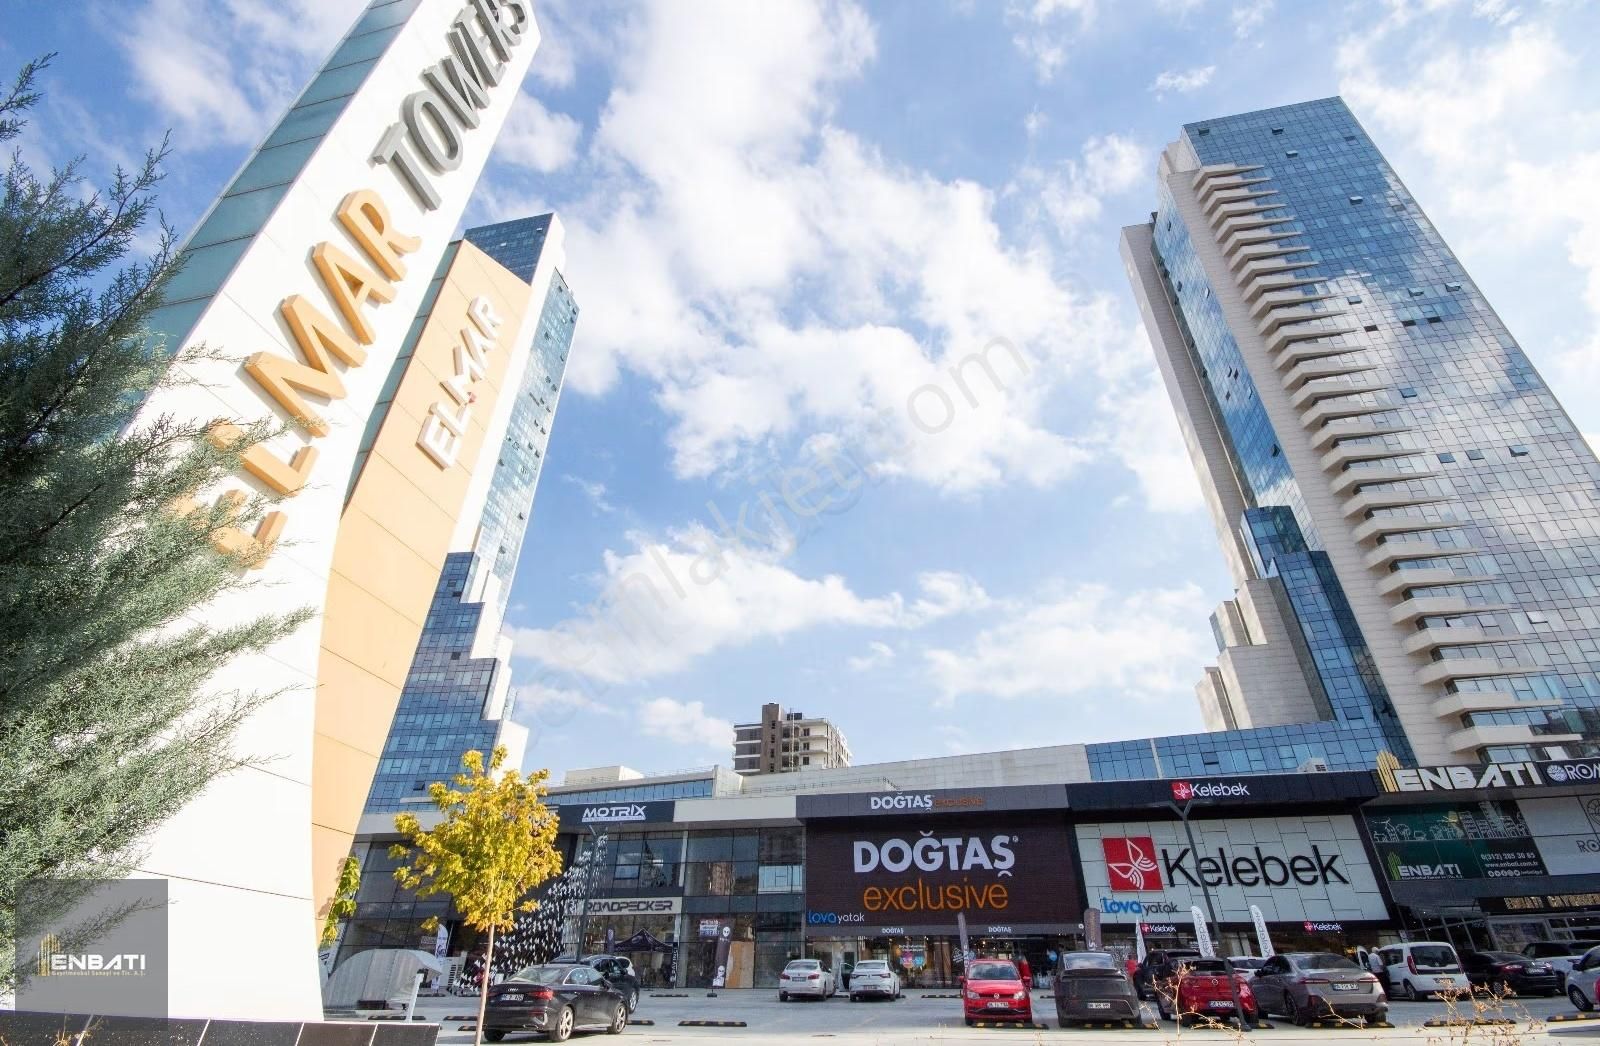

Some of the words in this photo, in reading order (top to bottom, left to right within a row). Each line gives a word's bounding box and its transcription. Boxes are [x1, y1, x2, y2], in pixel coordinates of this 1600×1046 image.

[415, 296, 504, 471] ELMAR
[1393, 762, 1543, 792] ENBATI
[1190, 783, 1250, 797] Kelebek
[871, 792, 933, 812] DOĞTAŞ
[582, 804, 646, 818] MOTRIX
[853, 830, 1015, 877] DOĞTAŞ
[1161, 845, 1350, 888] Kelebek
[1398, 864, 1461, 877] ENBATI
[863, 877, 1009, 911] exclusive
[587, 900, 673, 912] ROADPECKER
[1142, 901, 1178, 916] yatak
[837, 912, 865, 925] yatak
[1149, 924, 1177, 933] Kelebek
[1312, 922, 1343, 931] Kelebek
